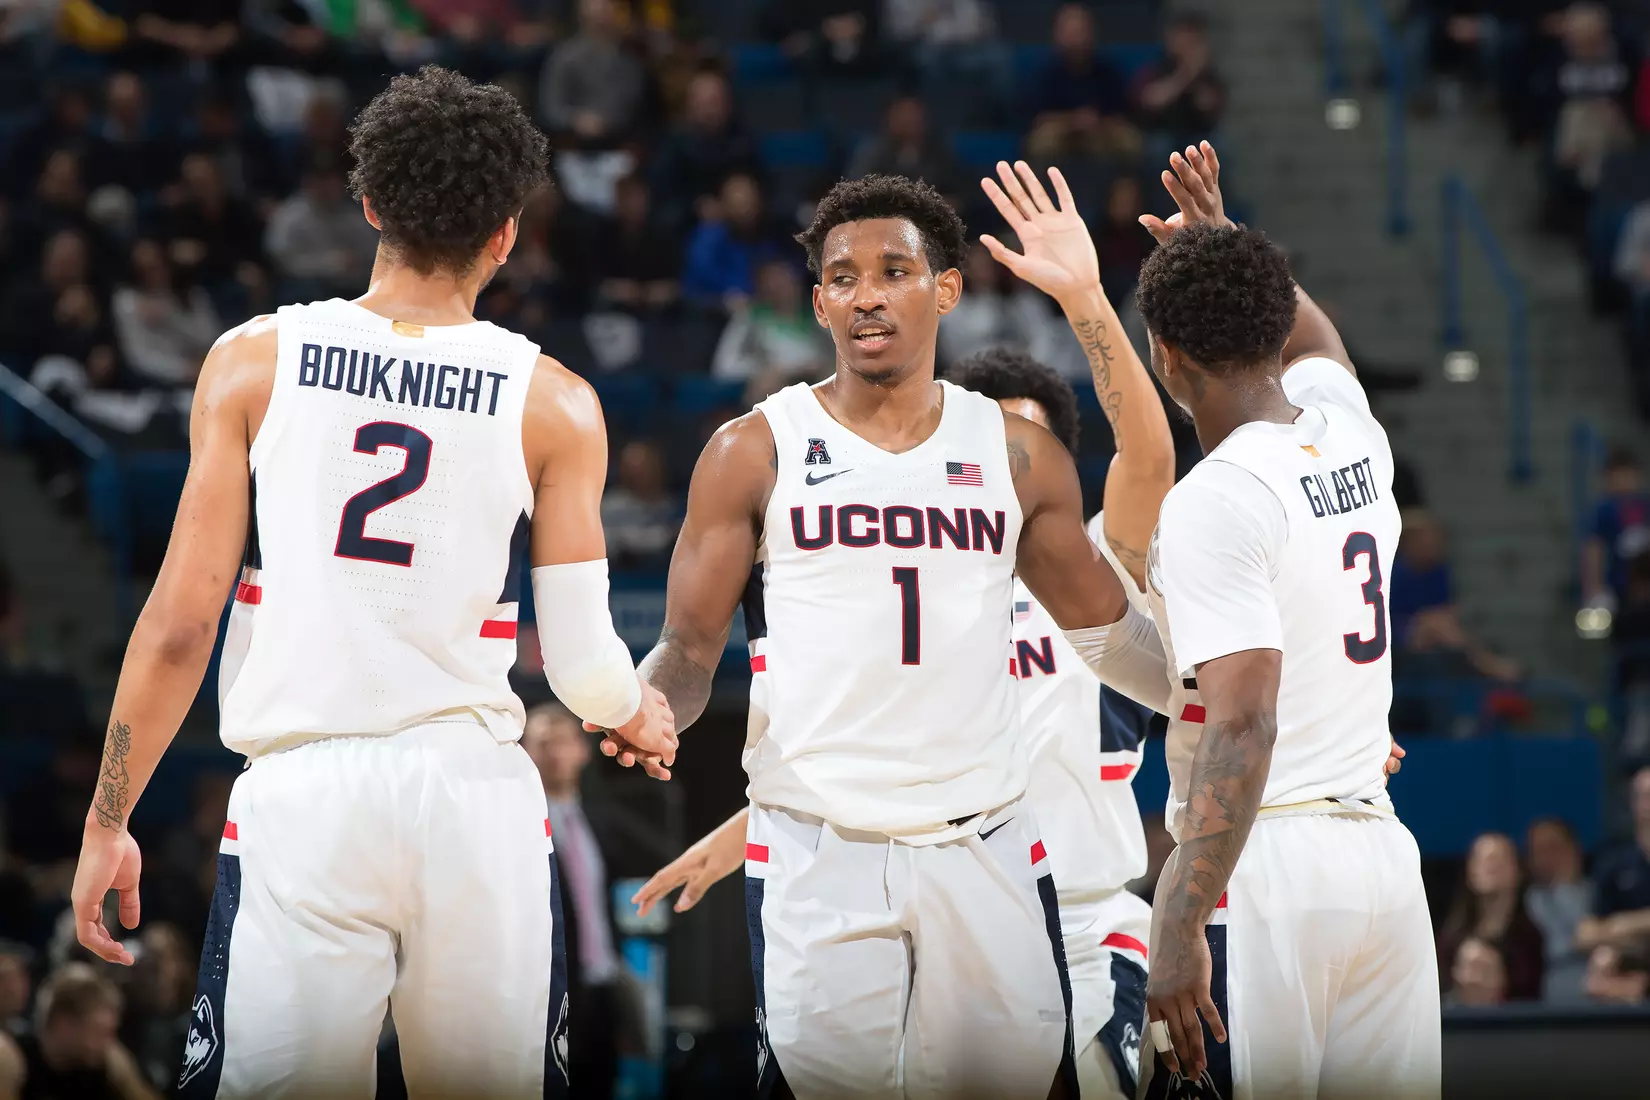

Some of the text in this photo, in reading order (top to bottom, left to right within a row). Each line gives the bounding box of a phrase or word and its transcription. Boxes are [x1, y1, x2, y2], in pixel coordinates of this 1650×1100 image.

[298, 343, 509, 417] BOUKNIGHT
[333, 420, 434, 568] 2
[789, 503, 1007, 556] UCONN
[1300, 456, 1380, 518] GILBERT
[891, 566, 921, 666] 1
[1342, 530, 1388, 665] 3
